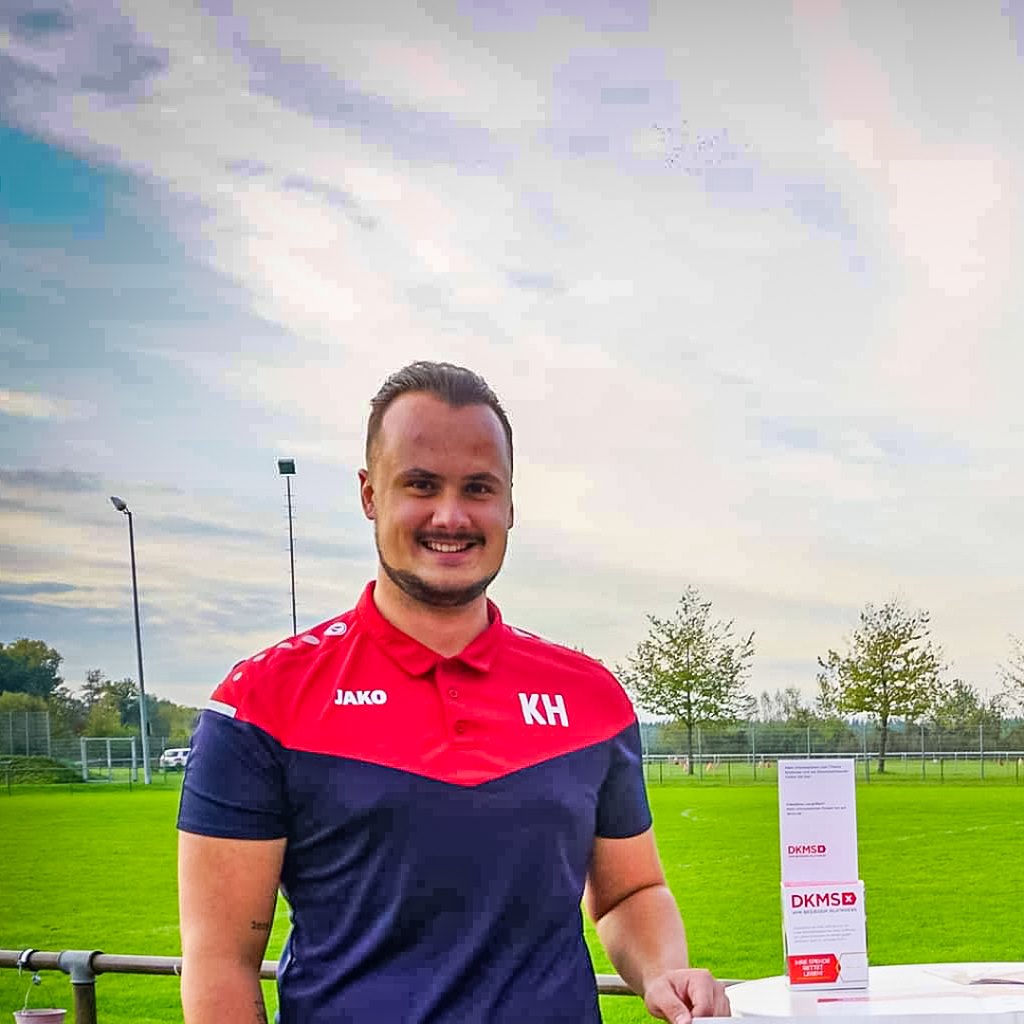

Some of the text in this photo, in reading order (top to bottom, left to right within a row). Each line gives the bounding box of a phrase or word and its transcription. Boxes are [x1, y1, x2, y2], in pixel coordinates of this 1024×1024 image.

[335, 689, 387, 706] JAKO
[518, 692, 569, 728] KH
[791, 892, 841, 908] DKMS
